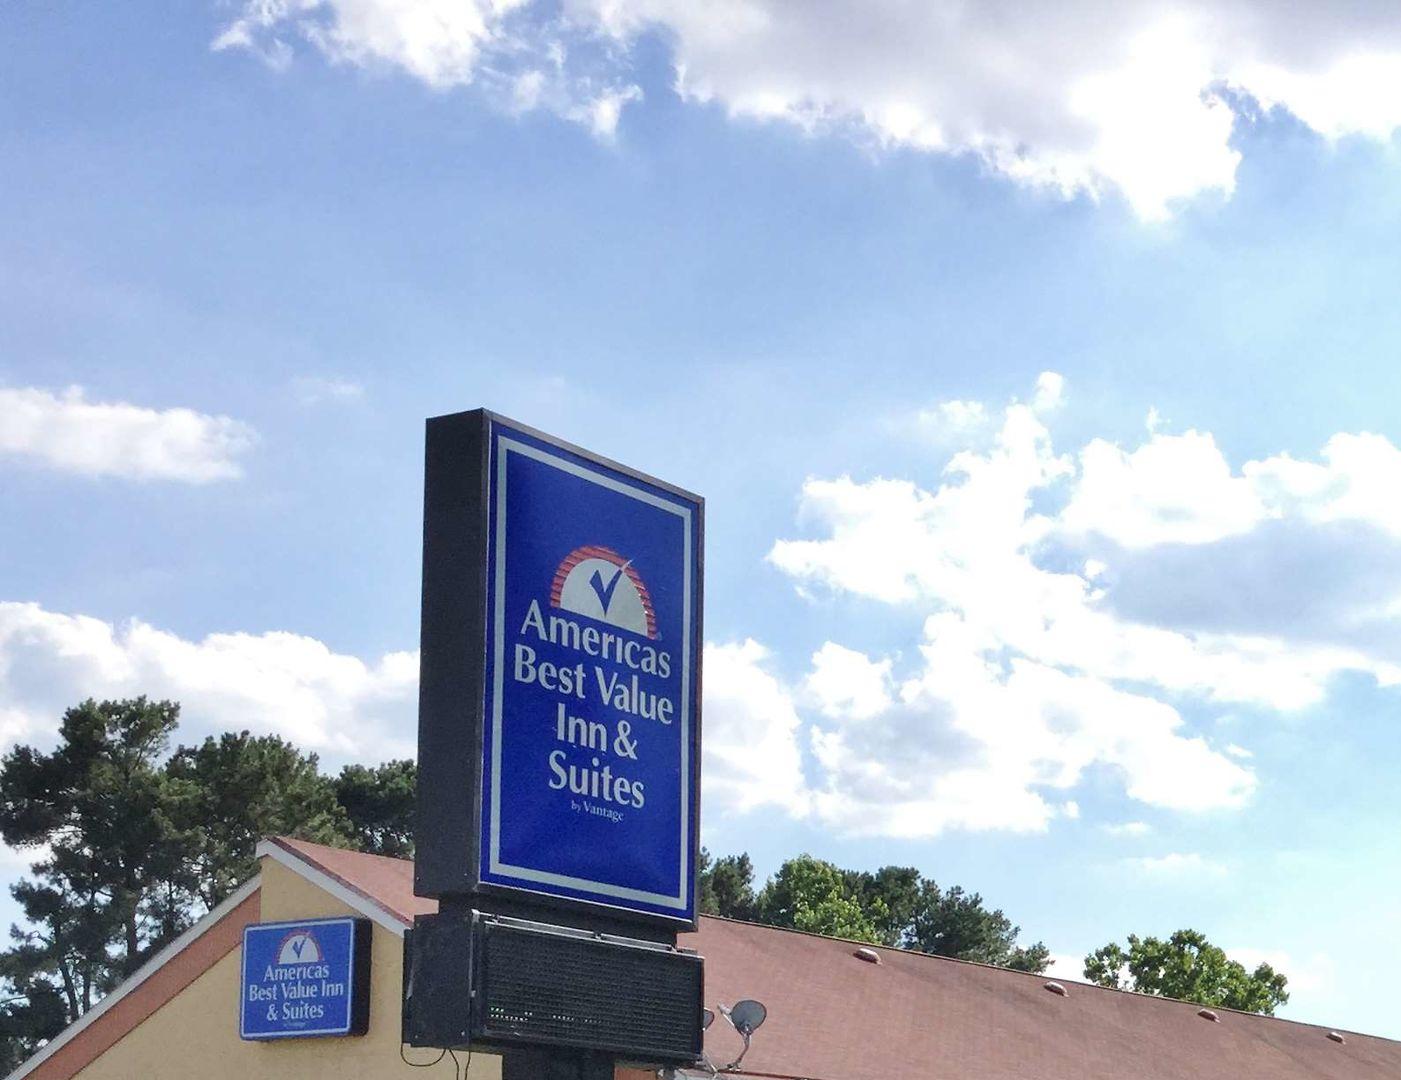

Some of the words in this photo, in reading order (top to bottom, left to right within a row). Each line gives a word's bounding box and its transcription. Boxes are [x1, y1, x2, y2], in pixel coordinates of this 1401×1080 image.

[520, 599, 671, 679] Americas
[514, 643, 586, 699] Best
[594, 666, 673, 724] Value
[556, 702, 608, 752] Inn
[613, 720, 639, 760] &
[548, 750, 645, 809] Suites
[571, 800, 581, 814] by
[583, 800, 625, 823] Vantage
[249, 984, 278, 1001] Best
[280, 980, 318, 1000] Value
[321, 980, 344, 997] Inn
[263, 964, 330, 982] Americas
[266, 1003, 279, 1021] &
[282, 1000, 324, 1020] Suites
